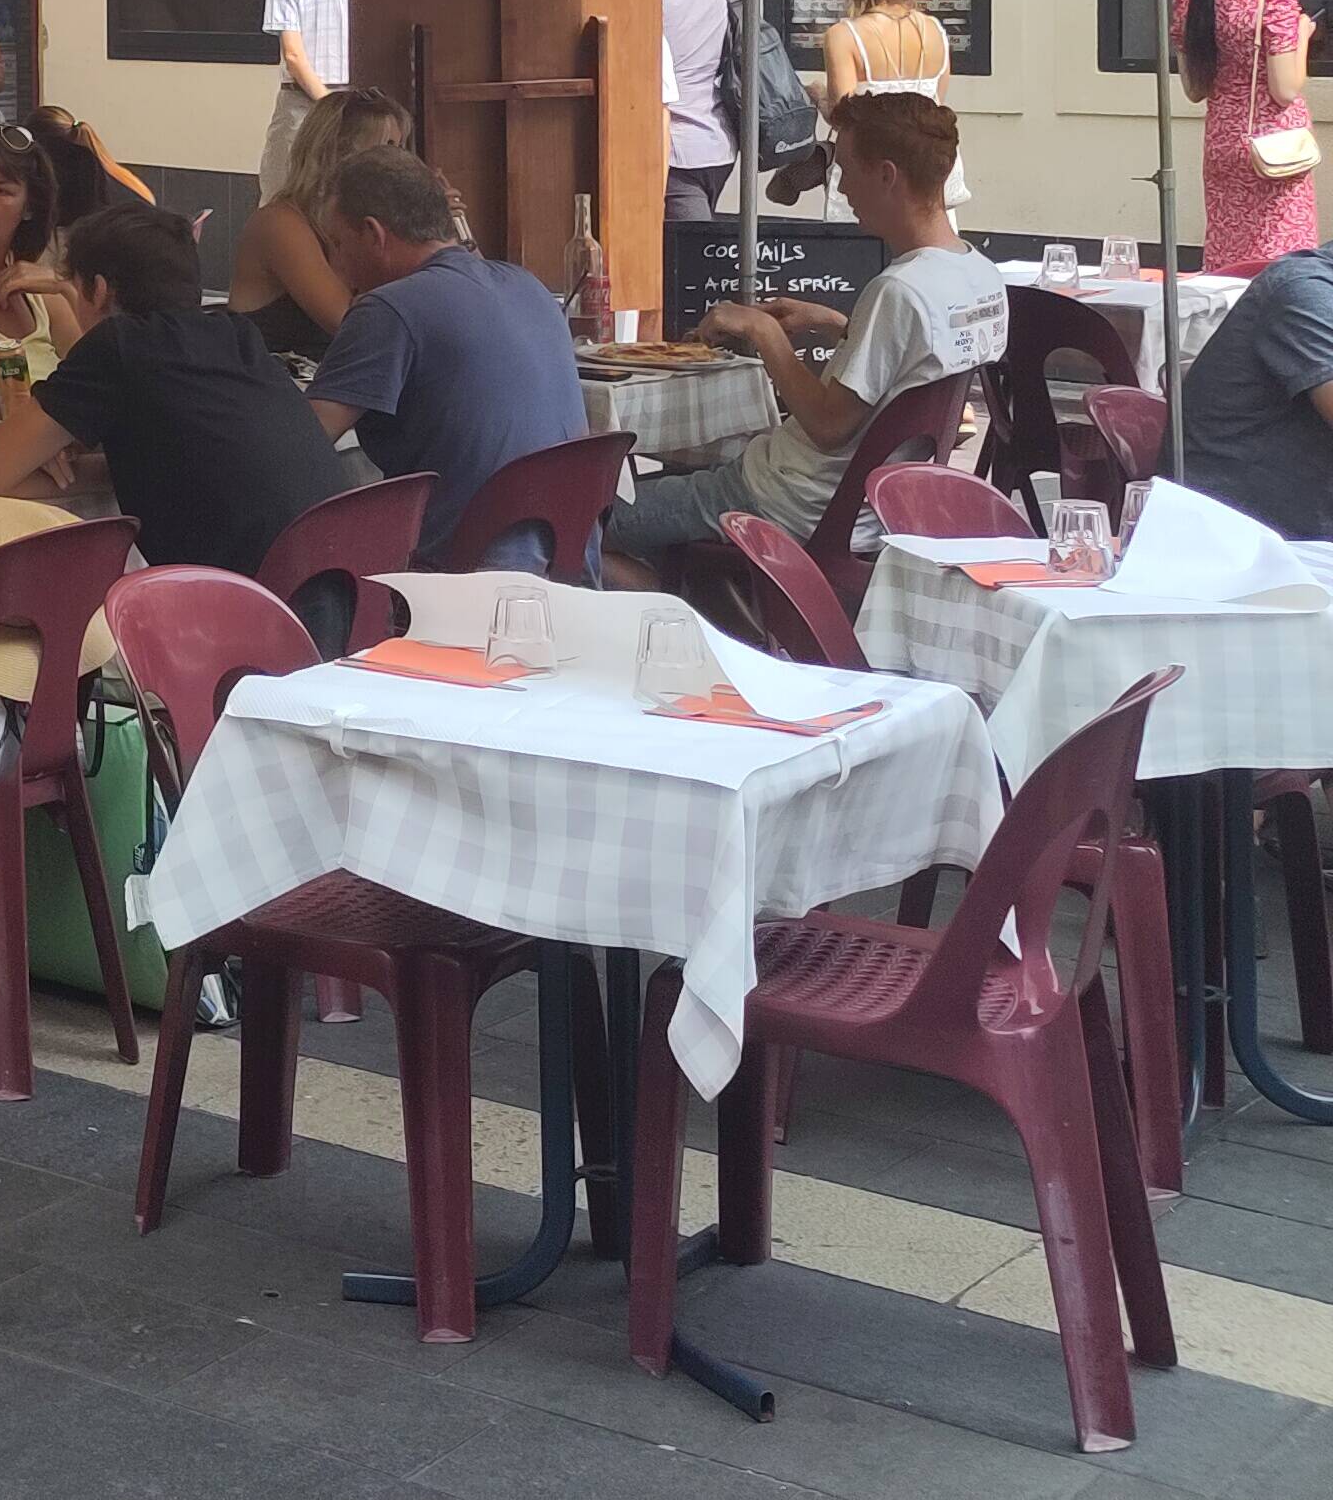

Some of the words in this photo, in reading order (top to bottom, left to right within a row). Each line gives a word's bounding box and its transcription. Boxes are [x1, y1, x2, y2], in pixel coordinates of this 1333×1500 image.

[703, 239, 805, 263] COCTAILS
[704, 277, 778, 292] APEOL
[787, 275, 855, 292] SPRITZ
